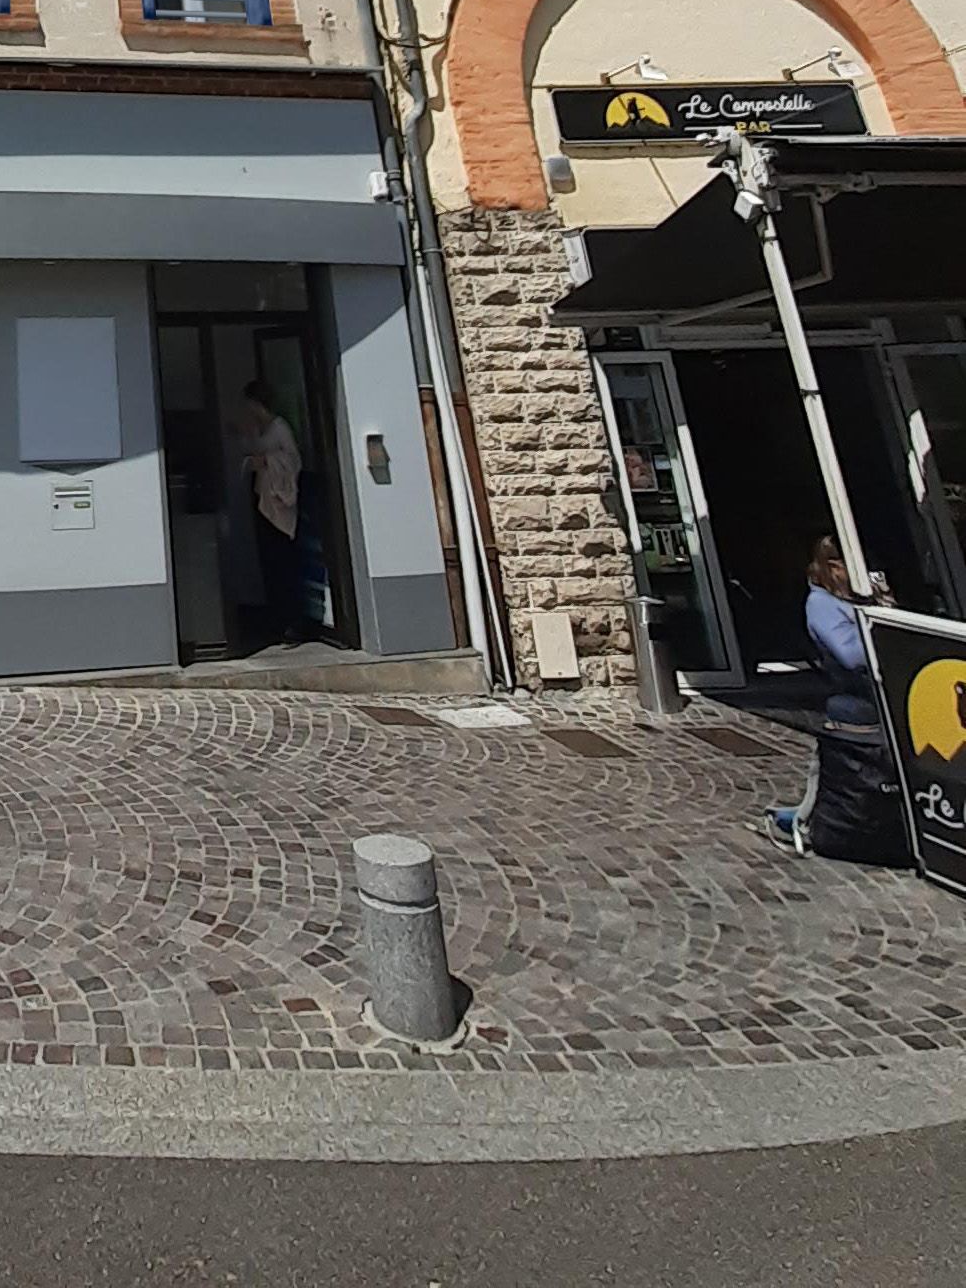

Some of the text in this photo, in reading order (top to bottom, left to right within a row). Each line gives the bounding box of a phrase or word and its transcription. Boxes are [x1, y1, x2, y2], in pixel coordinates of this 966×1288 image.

[677, 93, 814, 119] Le Compostelle
[735, 120, 772, 134] BAR
[915, 783, 964, 828] Le
